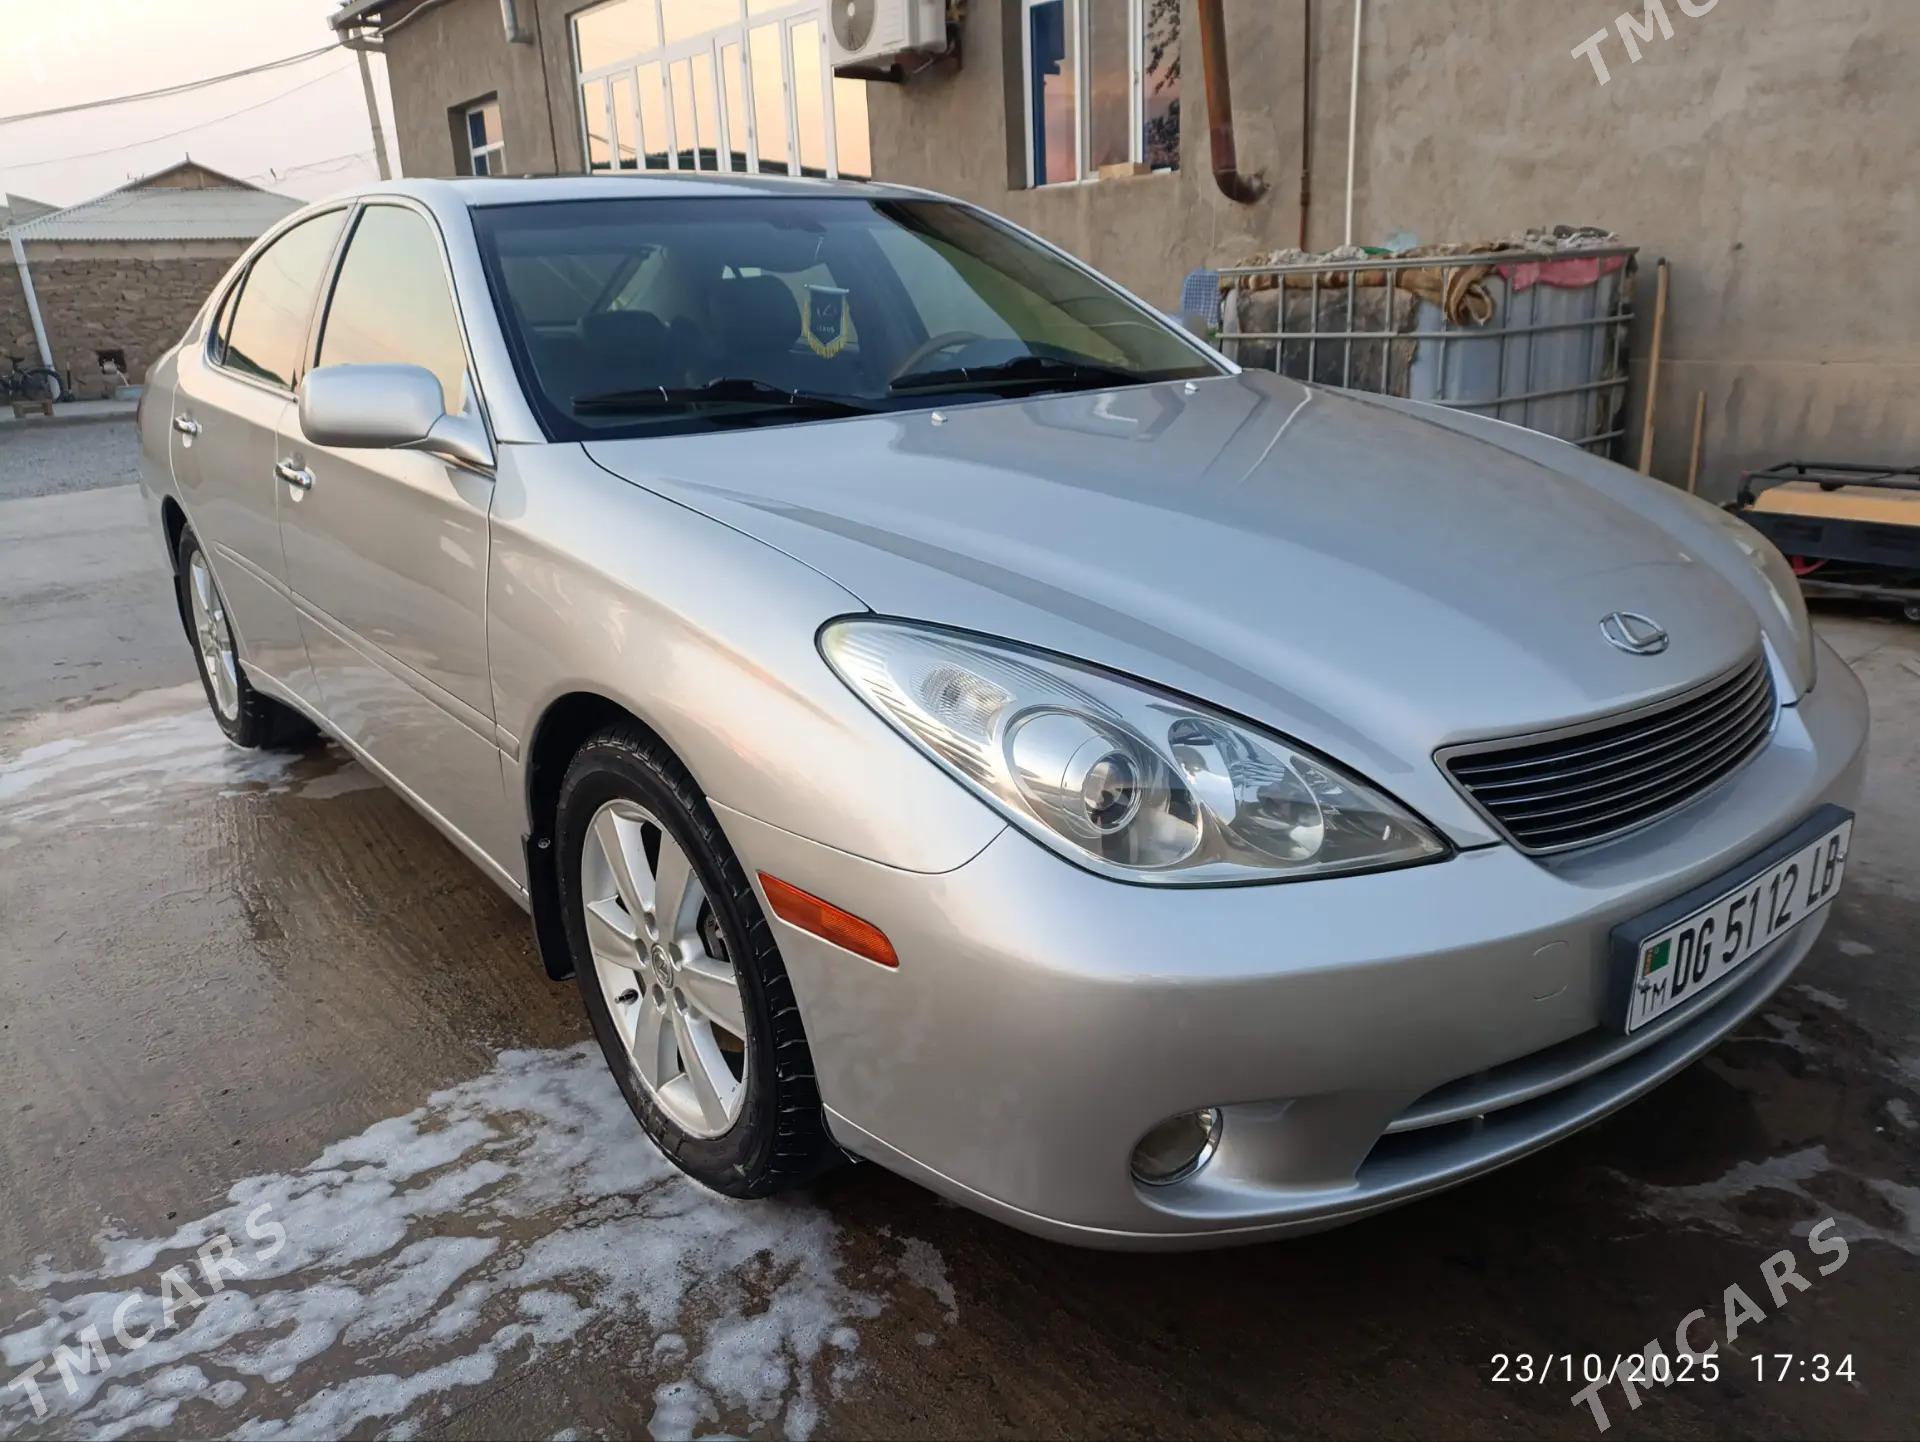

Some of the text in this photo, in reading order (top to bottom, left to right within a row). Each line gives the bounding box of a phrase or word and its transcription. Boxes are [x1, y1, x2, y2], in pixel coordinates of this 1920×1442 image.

[1670, 834, 1840, 998] DG 5112 LB
[1639, 978, 1668, 1016] TM
